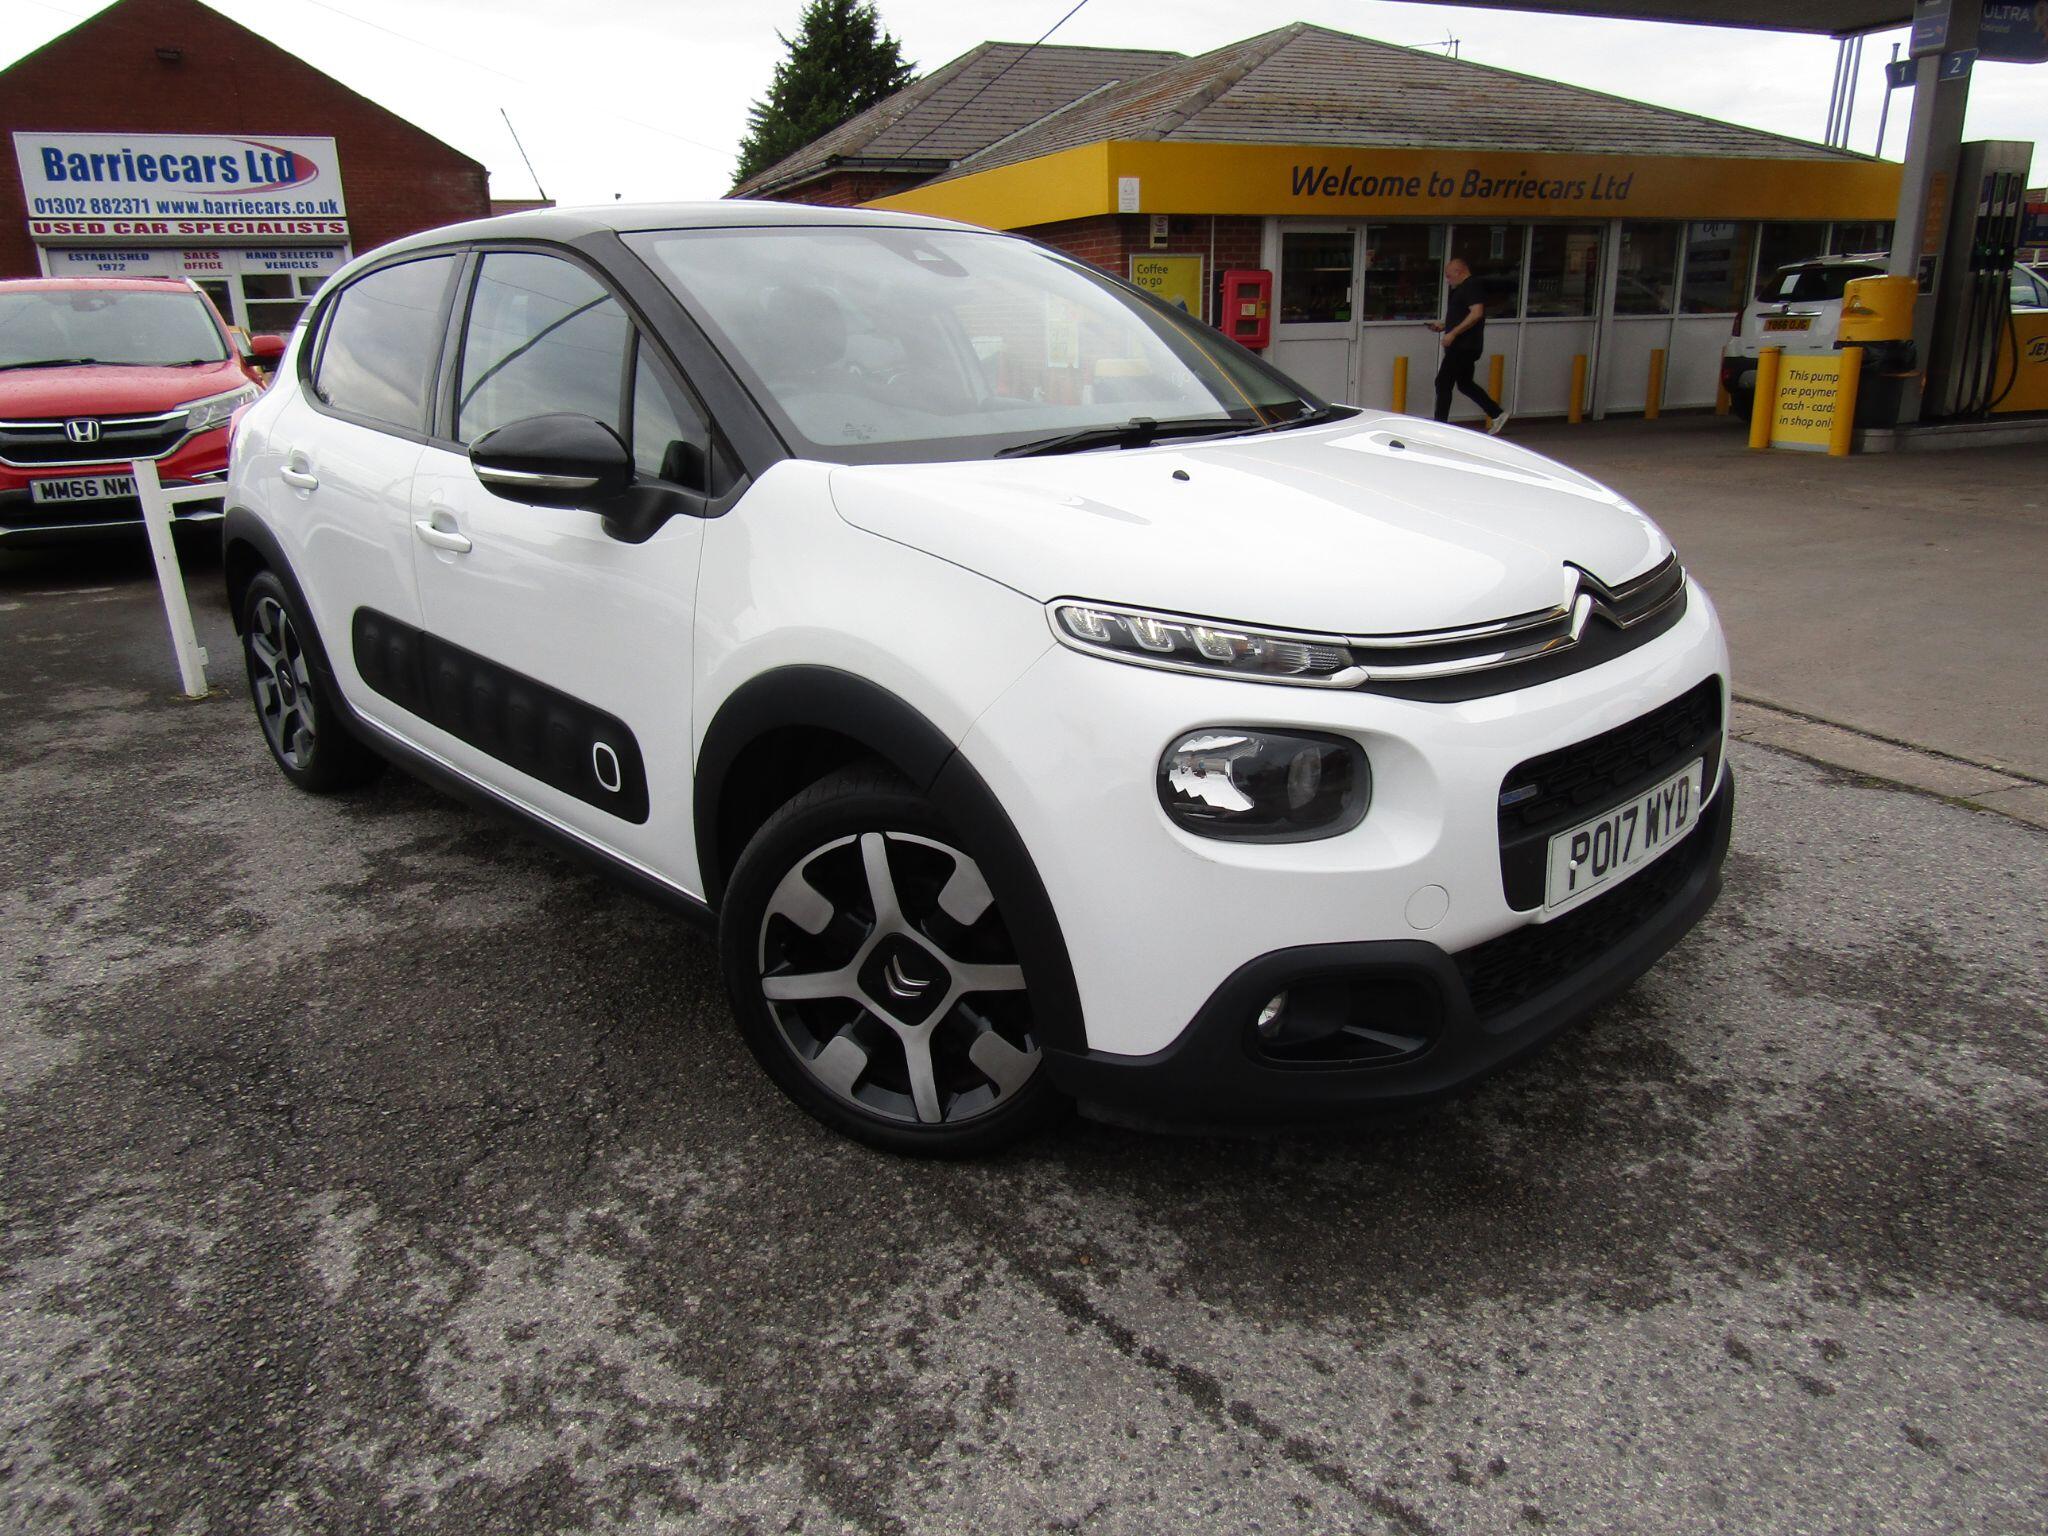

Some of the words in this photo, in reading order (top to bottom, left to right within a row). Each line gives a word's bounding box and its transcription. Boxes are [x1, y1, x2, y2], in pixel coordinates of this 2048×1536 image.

[1983, 4, 2030, 21] ULTRA
[1950, 57, 1962, 74] 2
[1900, 66, 1906, 82] 1
[41, 147, 239, 183] Barriecars
[245, 150, 297, 183] Ltd
[1292, 165, 1420, 197] Welcome
[1427, 171, 1455, 198] to
[1460, 169, 1587, 199] Barriecars
[1590, 172, 1634, 200] Ltd
[34, 198, 87, 214] 01302
[90, 198, 150, 215] 882371
[156, 199, 339, 215] www.barriecars.co.uk
[33, 222, 106, 234] USED
[113, 222, 169, 234] CAR
[178, 222, 345, 234] SPECIALISTS
[68, 253, 149, 261] ESTABLISHED
[183, 252, 220, 260] SALES
[246, 251, 278, 260] HAND
[280, 251, 334, 259] SELECTED
[97, 263, 126, 271] 1972
[184, 262, 224, 270] OFFICE
[265, 261, 319, 269] VEHICLES
[1137, 264, 1169, 275] Coffee
[1137, 276, 1148, 286] to
[1150, 278, 1162, 288] go
[1790, 370, 1809, 381] This
[1810, 373, 1839, 384] pump
[1781, 387, 1797, 398] pre
[1782, 401, 1804, 411] cash
[1779, 417, 1788, 425] in
[1790, 416, 1813, 429] shop
[41, 480, 98, 499] MM66
[103, 477, 138, 496] NW
[1569, 806, 1639, 891] PO17
[1645, 776, 1690, 849] WYD
